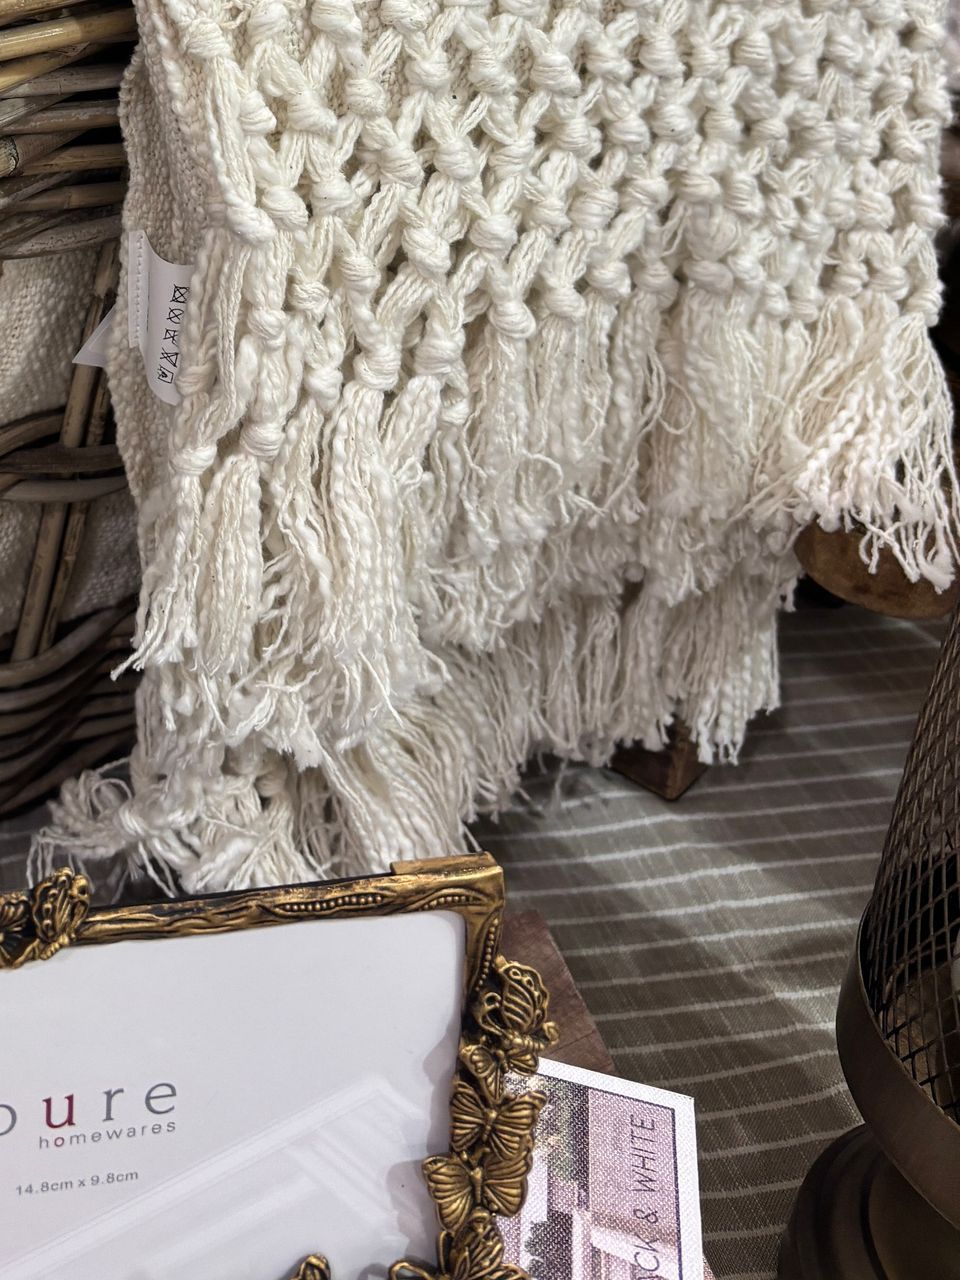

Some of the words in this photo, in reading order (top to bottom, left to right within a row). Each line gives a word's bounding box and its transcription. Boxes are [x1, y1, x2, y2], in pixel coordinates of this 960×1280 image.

[38, 1120, 177, 1151] homewares
[630, 1114, 656, 1194] WHITE
[15, 1178, 74, 1197] 14.8cm
[77, 1177, 87, 1188] x
[89, 1169, 140, 1188] 9.8cm
